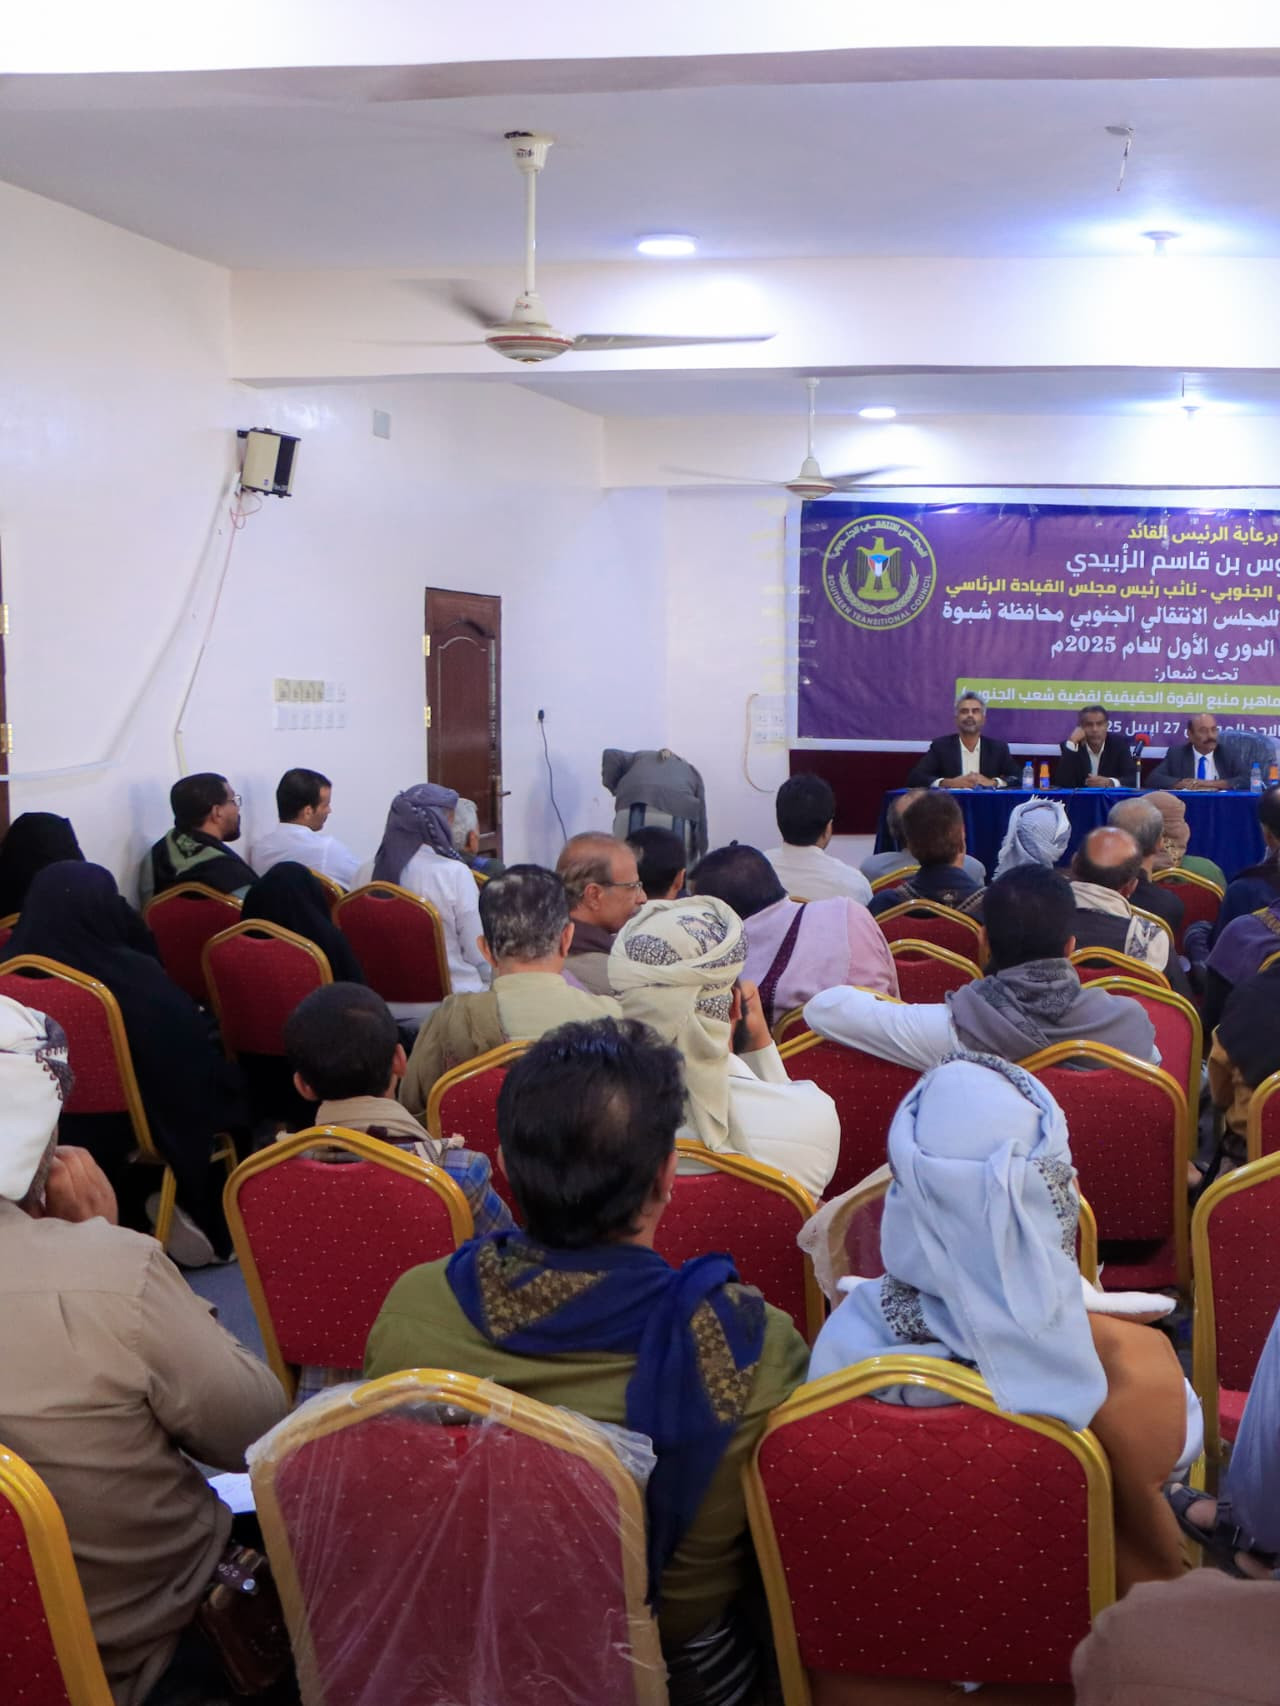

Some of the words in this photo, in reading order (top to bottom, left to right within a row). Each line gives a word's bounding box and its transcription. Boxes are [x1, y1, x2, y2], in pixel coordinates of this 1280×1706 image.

[1128, 524, 1168, 541] القائد
[1172, 525, 1228, 544] الرئيس
[1233, 525, 1279, 547] برعاية
[1151, 551, 1210, 576] قاسم
[1215, 553, 1240, 576] بن
[910, 575, 932, 611] COUNCIL
[946, 577, 1006, 595] الرئاسي
[1010, 579, 1064, 595] القيادة
[1068, 581, 1116, 598] مجلس
[1120, 580, 1159, 599] رئيس
[1163, 581, 1198, 599] نائب
[1210, 584, 1273, 604] الجنوبي
[942, 600, 992, 625] شبوة
[998, 601, 1064, 623] محافظة
[1070, 604, 1135, 631] الجنوبي
[1140, 605, 1208, 629] الانتقالي
[1213, 608, 1279, 630] للمجلس
[1050, 635, 1117, 659] 2025م
[1122, 636, 1162, 661] للعام
[1167, 634, 1208, 660] الأول
[1214, 638, 1274, 663] الدوري
[1154, 665, 1197, 683] شعار:
[1202, 666, 1239, 681] تحت
[1018, 687, 1054, 704] شعب
[1057, 688, 1101, 704] لقضية
[1103, 690, 1163, 706] الحقيقية
[1166, 690, 1203, 708] القوة
[1206, 693, 1239, 710] منبع
[1163, 721, 1180, 734] 27
